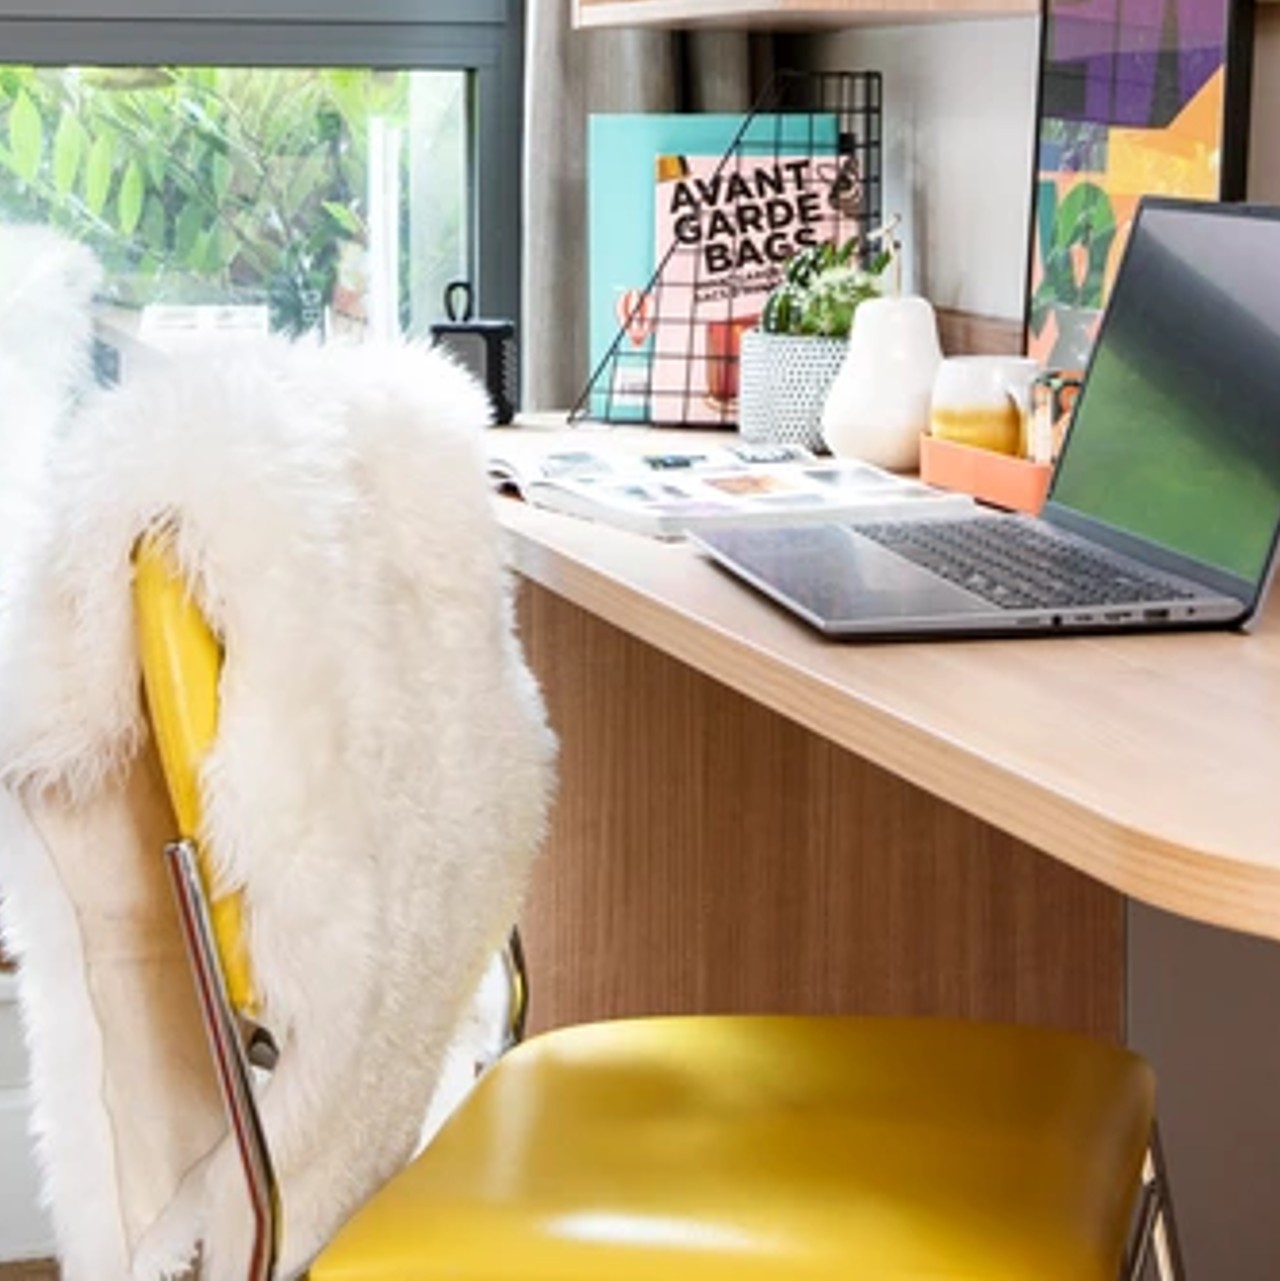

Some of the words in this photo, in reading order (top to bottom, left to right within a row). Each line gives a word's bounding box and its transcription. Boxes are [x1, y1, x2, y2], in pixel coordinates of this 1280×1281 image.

[670, 159, 811, 214] AVANT
[674, 193, 822, 245] GARDE
[704, 227, 819, 274] BAGS
